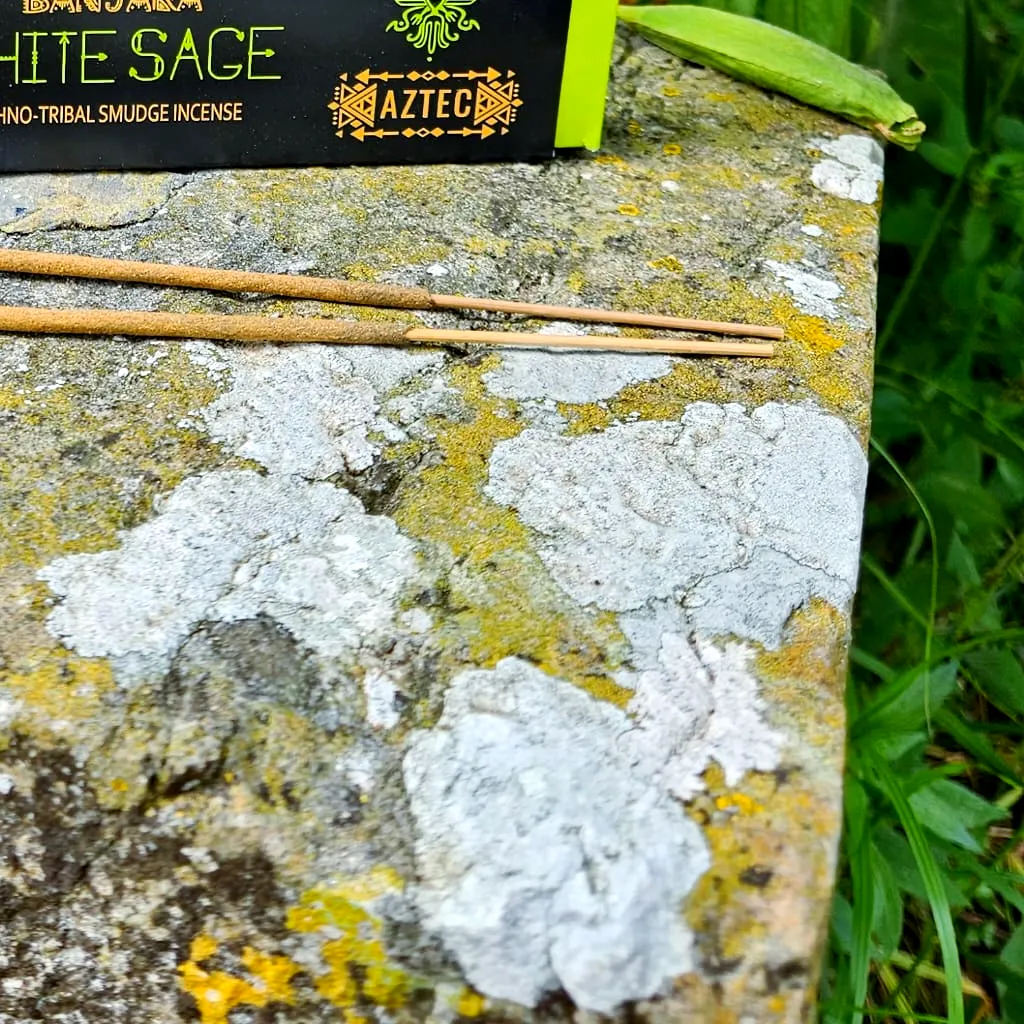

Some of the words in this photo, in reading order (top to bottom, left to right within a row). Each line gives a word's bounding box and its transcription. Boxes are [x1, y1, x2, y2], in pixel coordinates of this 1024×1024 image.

[128, 26, 285, 82] SAGE
[98, 103, 170, 123] SMUDGE
[173, 102, 243, 122] INCENSE
[379, 88, 473, 120] AZTEC
